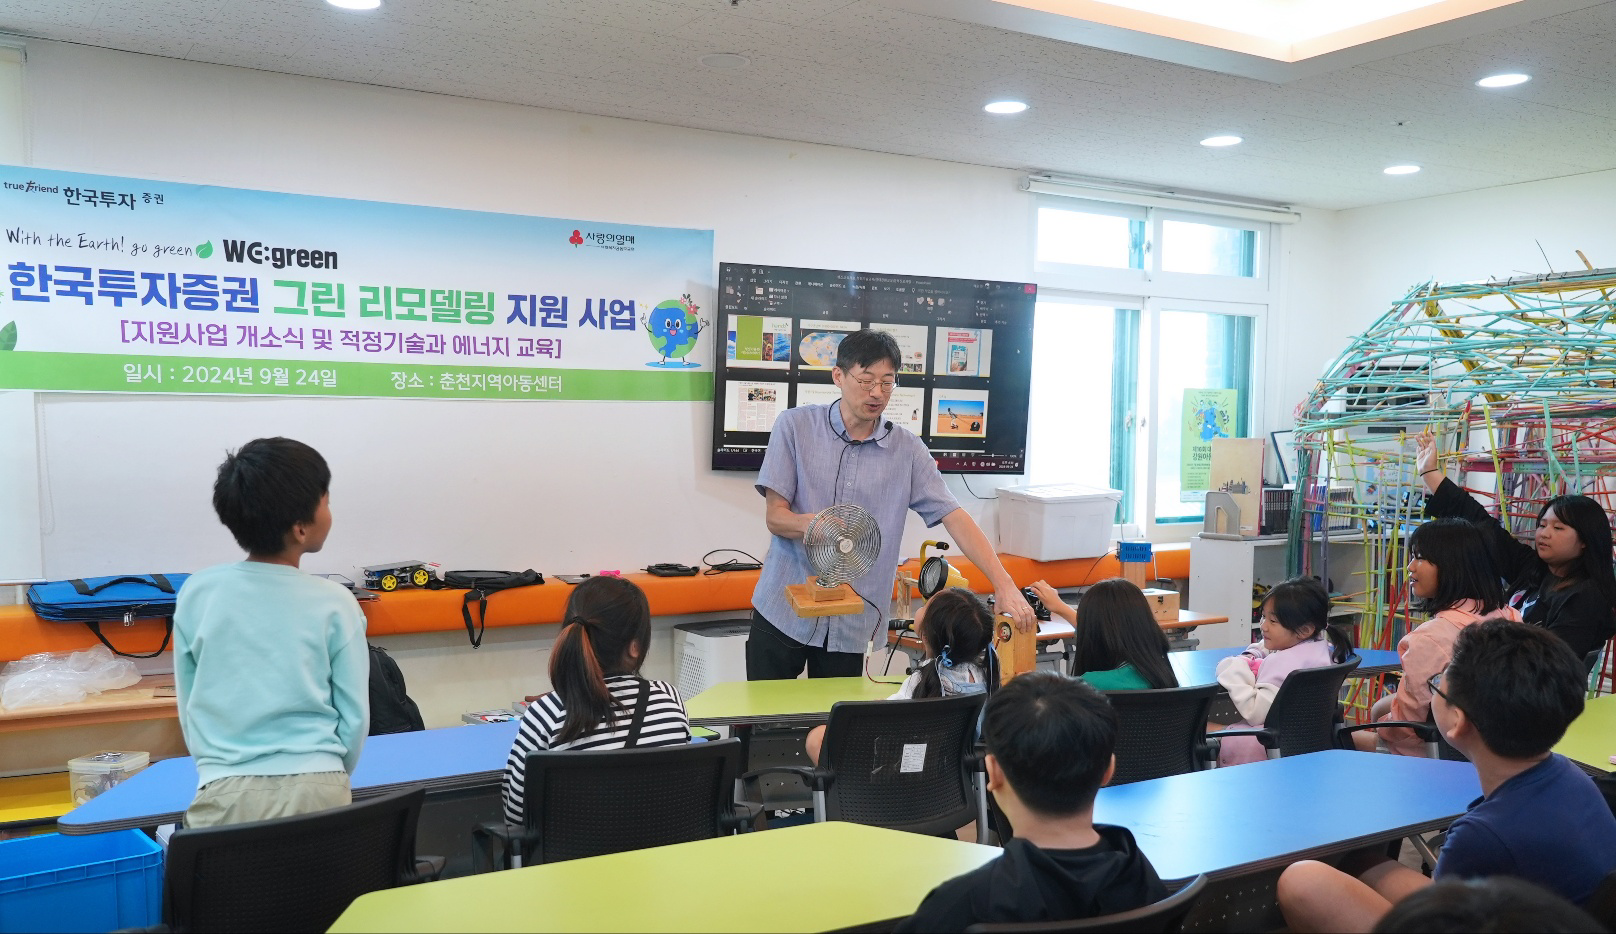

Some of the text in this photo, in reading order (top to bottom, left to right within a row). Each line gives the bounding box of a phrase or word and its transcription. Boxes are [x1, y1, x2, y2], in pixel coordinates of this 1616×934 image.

[63, 187, 164, 210] 한국투자 증권
[6, 227, 193, 259] With the Earth! go green
[585, 232, 635, 246] 사랑의열매
[8, 261, 636, 331] 한국투자증권 그린 리모델링 지원 사업
[120, 319, 562, 359] [지원사업 개소식 및 적정기술과 에너지 교육]
[123, 363, 162, 384] 일시
[182, 365, 254, 386] 2024년
[259, 367, 290, 387] 9월
[295, 368, 337, 388] 24일
[390, 371, 425, 390] 장소
[439, 373, 563, 393] 춘천지역아동센터
